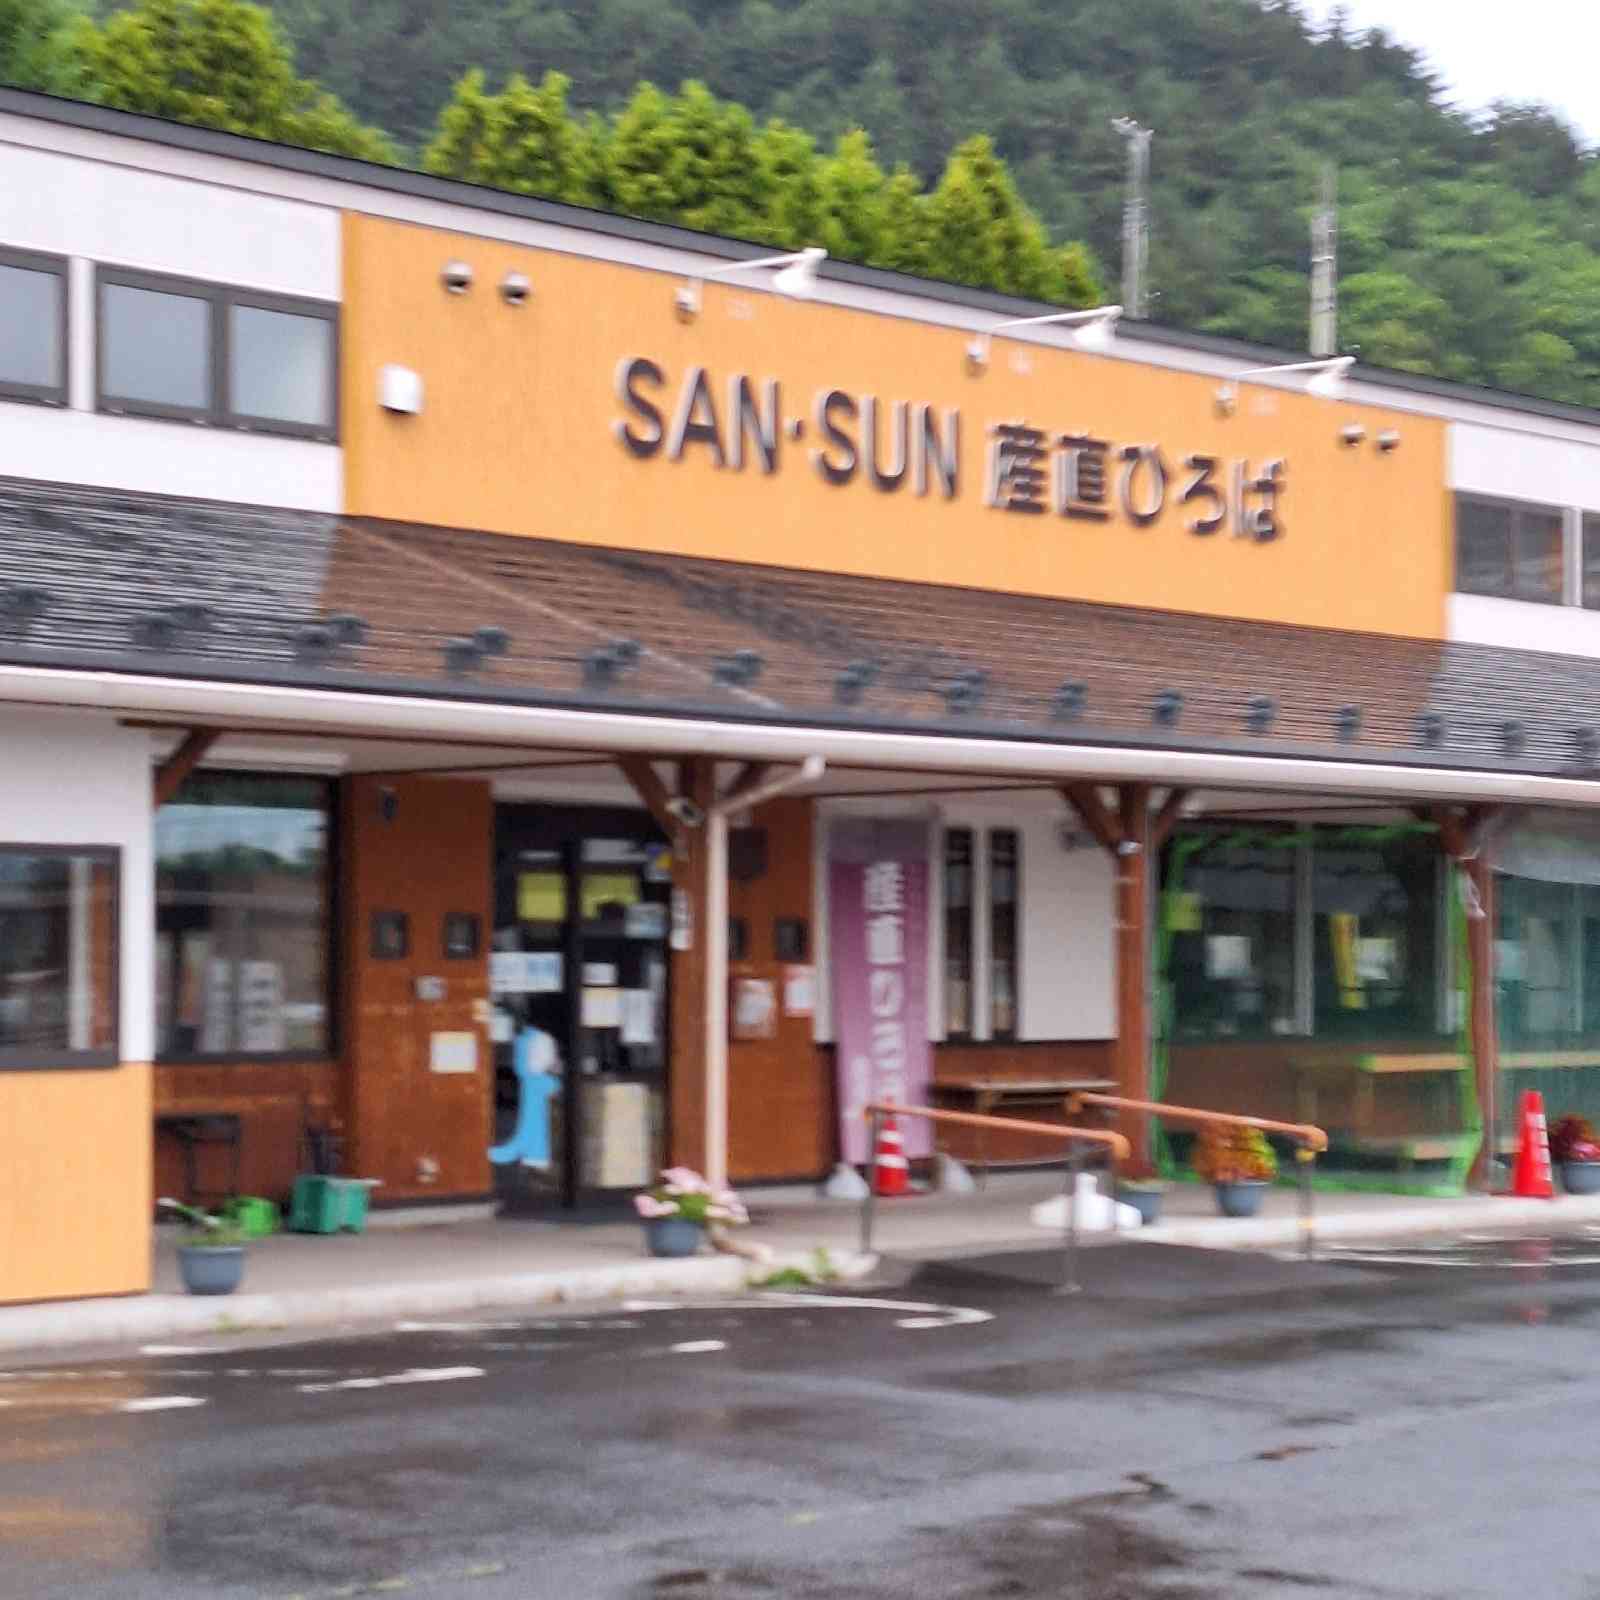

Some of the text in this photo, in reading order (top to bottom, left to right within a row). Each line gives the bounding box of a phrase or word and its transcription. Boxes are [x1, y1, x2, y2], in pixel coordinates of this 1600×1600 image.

[985, 421, 1287, 542] 産直ひろば
